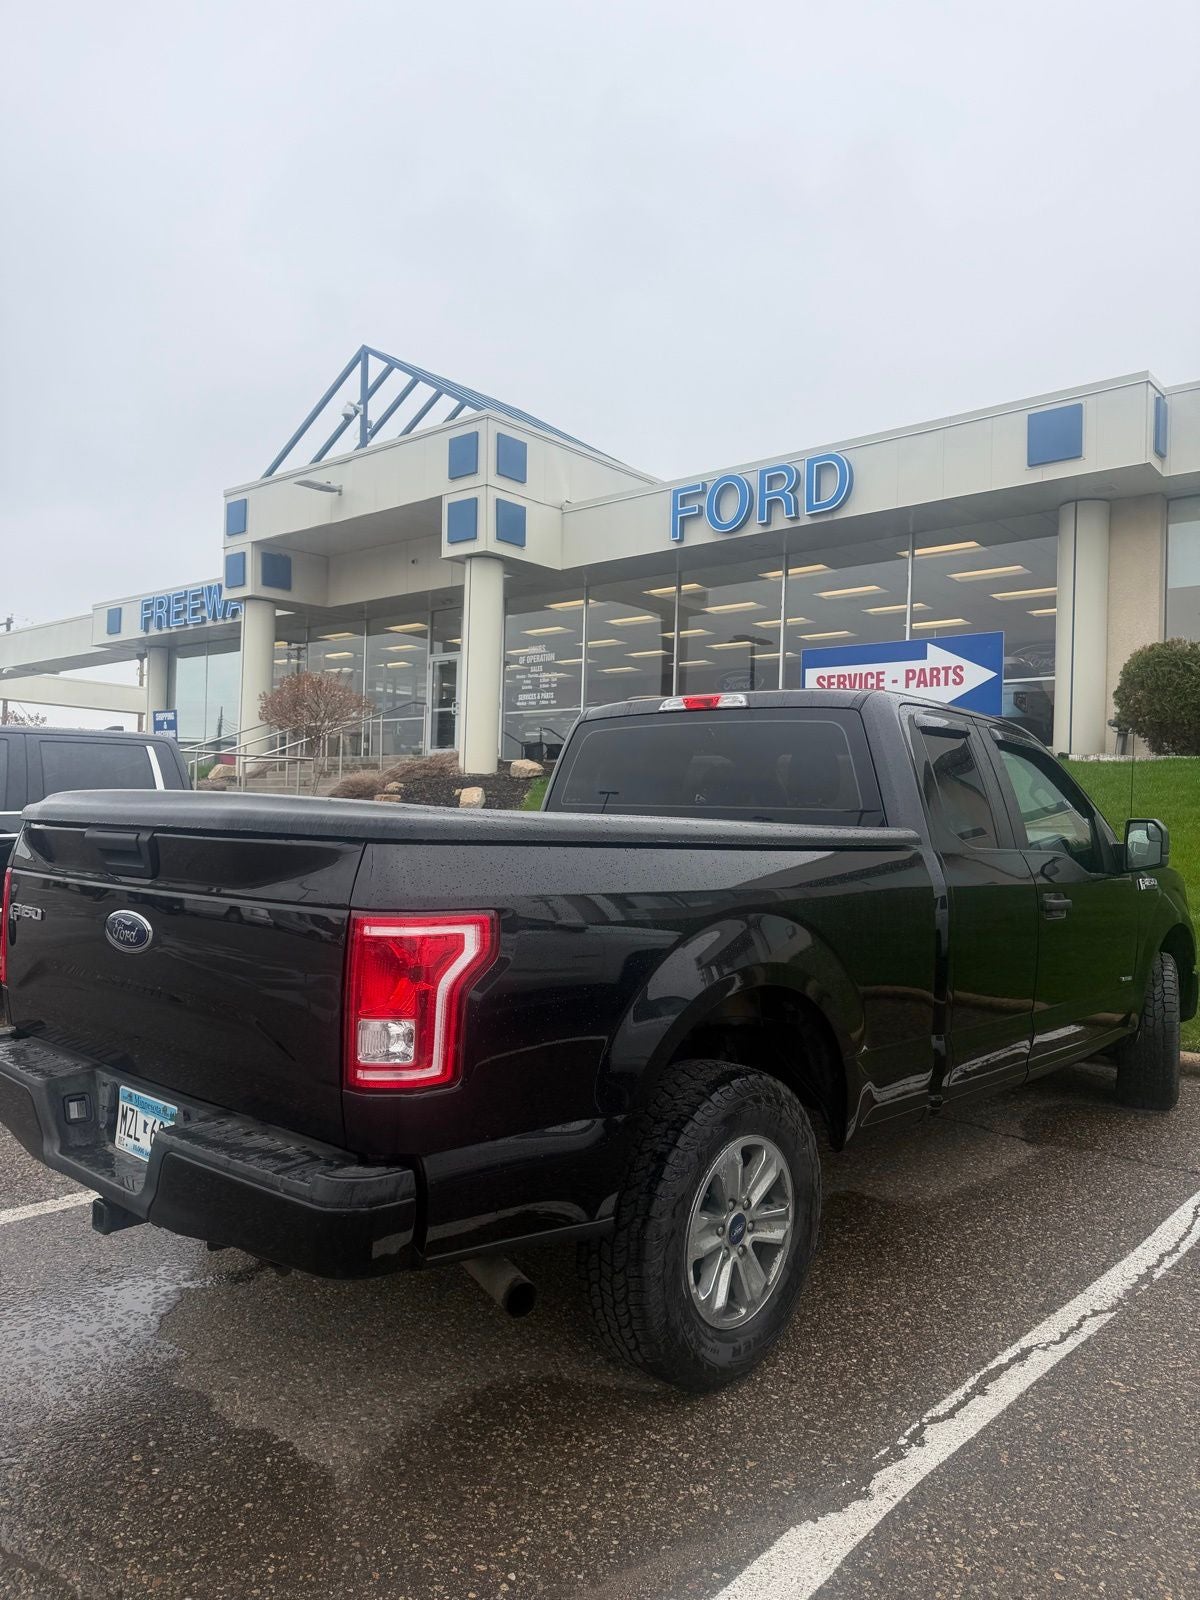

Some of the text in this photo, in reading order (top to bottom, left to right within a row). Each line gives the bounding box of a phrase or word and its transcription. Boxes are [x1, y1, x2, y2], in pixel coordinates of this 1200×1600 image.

[671, 452, 852, 541] FORD
[526, 653, 555, 663] OPERATION
[816, 671, 885, 691] SERVICE
[905, 665, 965, 688] PARTS
[120, 1104, 140, 1142] MZL
